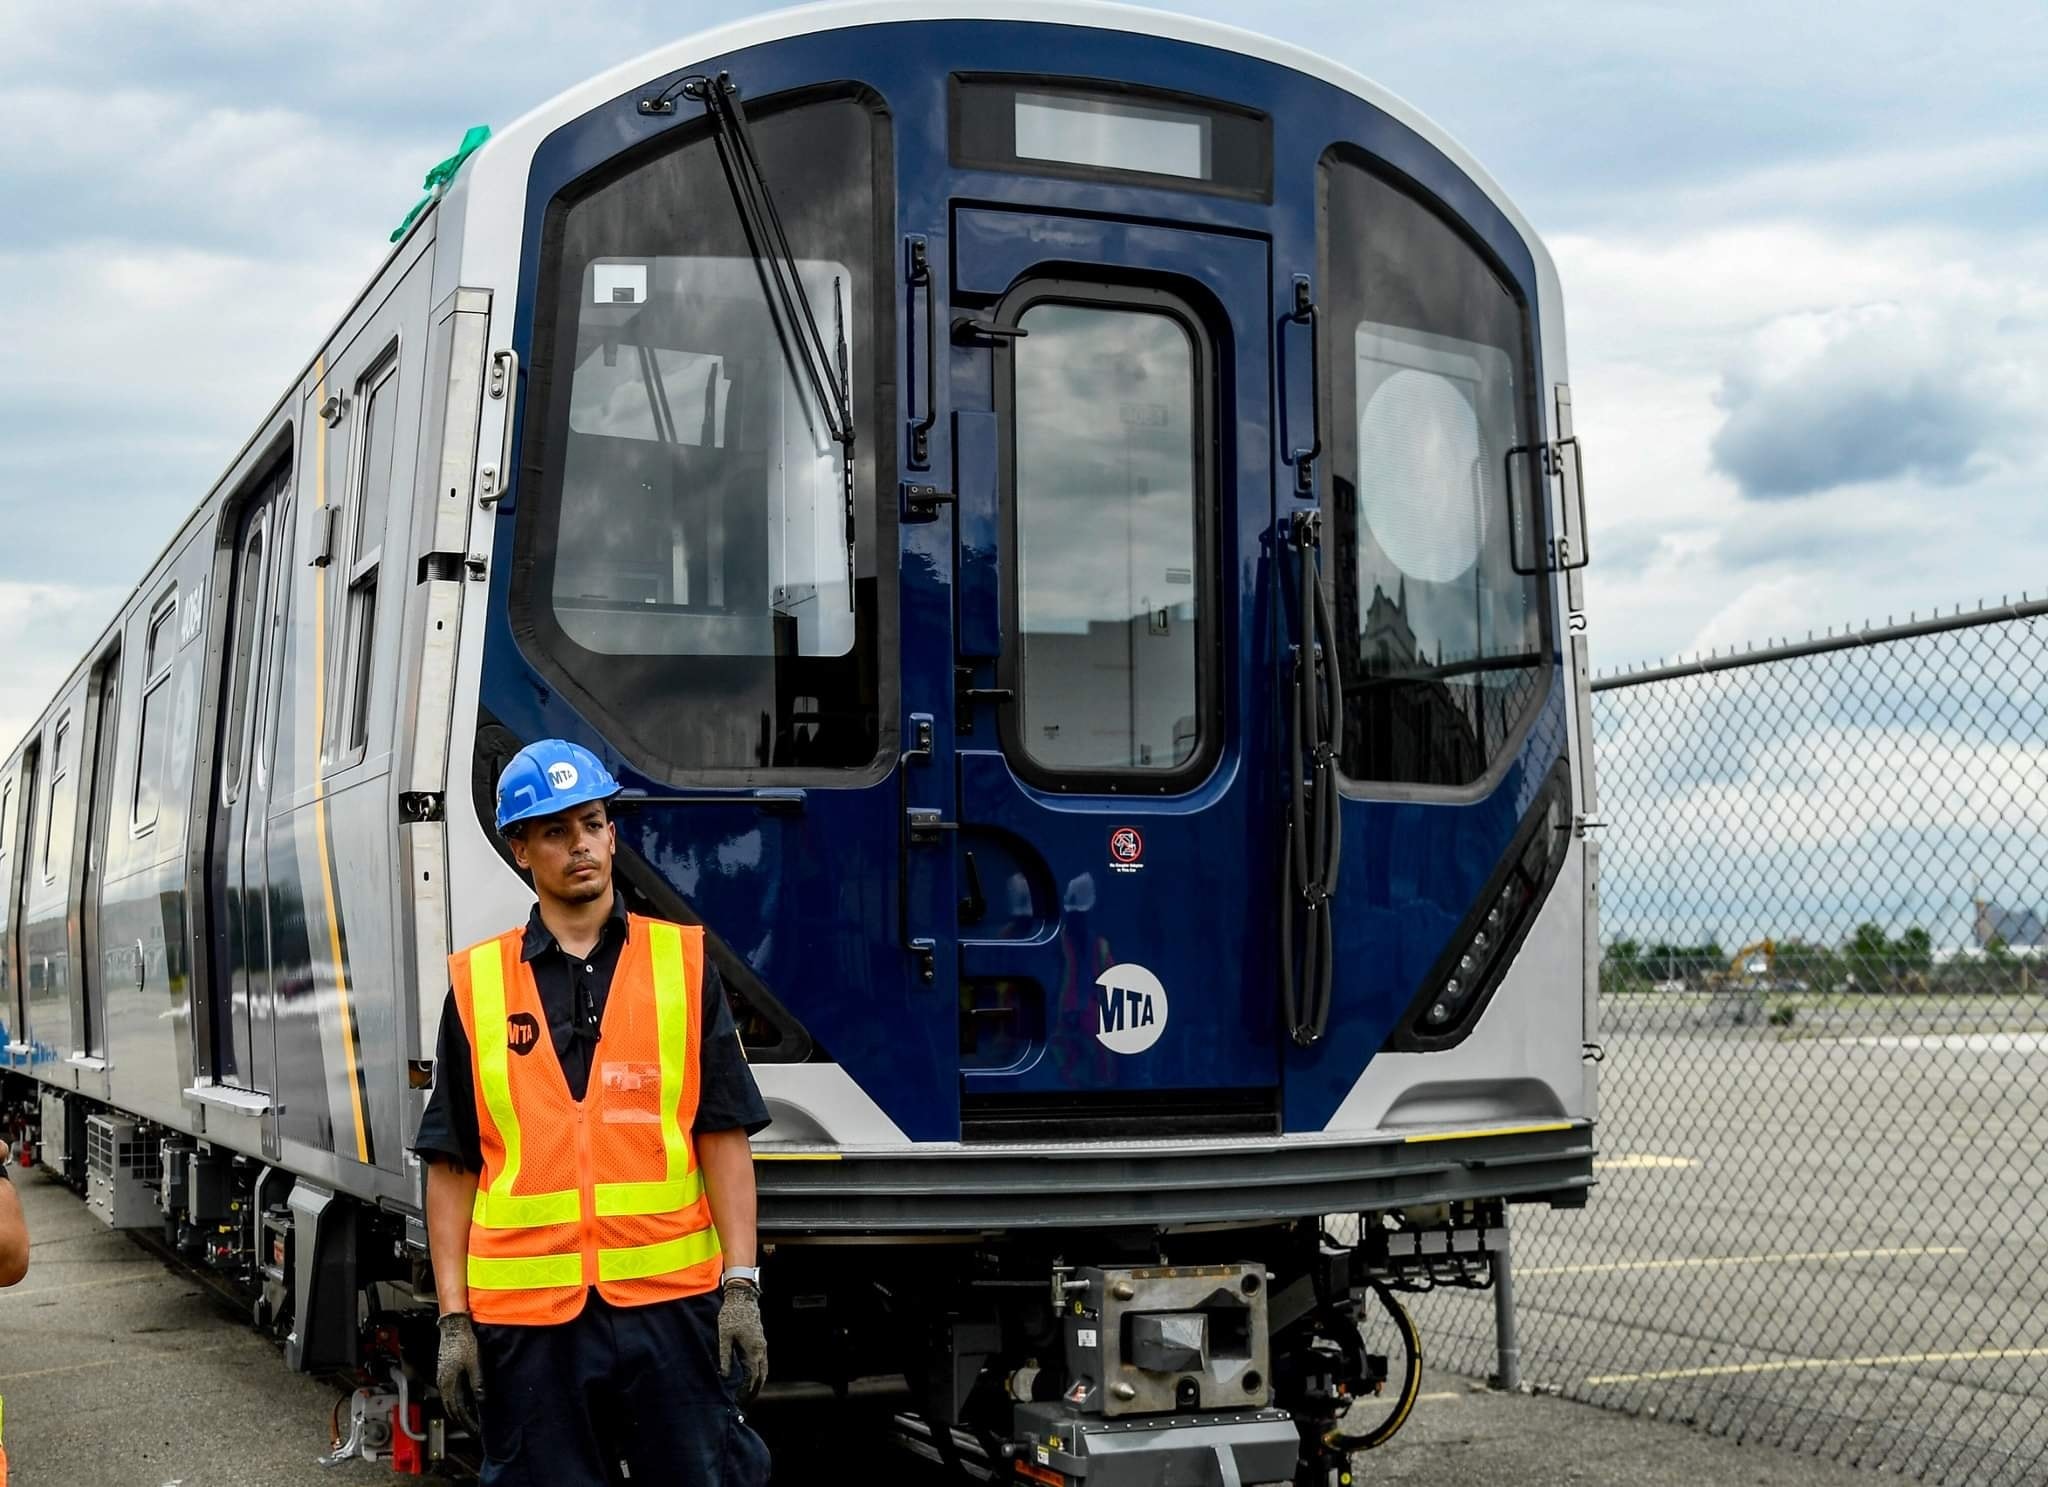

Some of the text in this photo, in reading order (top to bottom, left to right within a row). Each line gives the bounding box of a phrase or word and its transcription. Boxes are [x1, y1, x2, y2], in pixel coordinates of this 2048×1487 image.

[549, 769, 574, 786] MTA
[1096, 984, 1154, 1035] MTA
[507, 1020, 533, 1045] MTA
